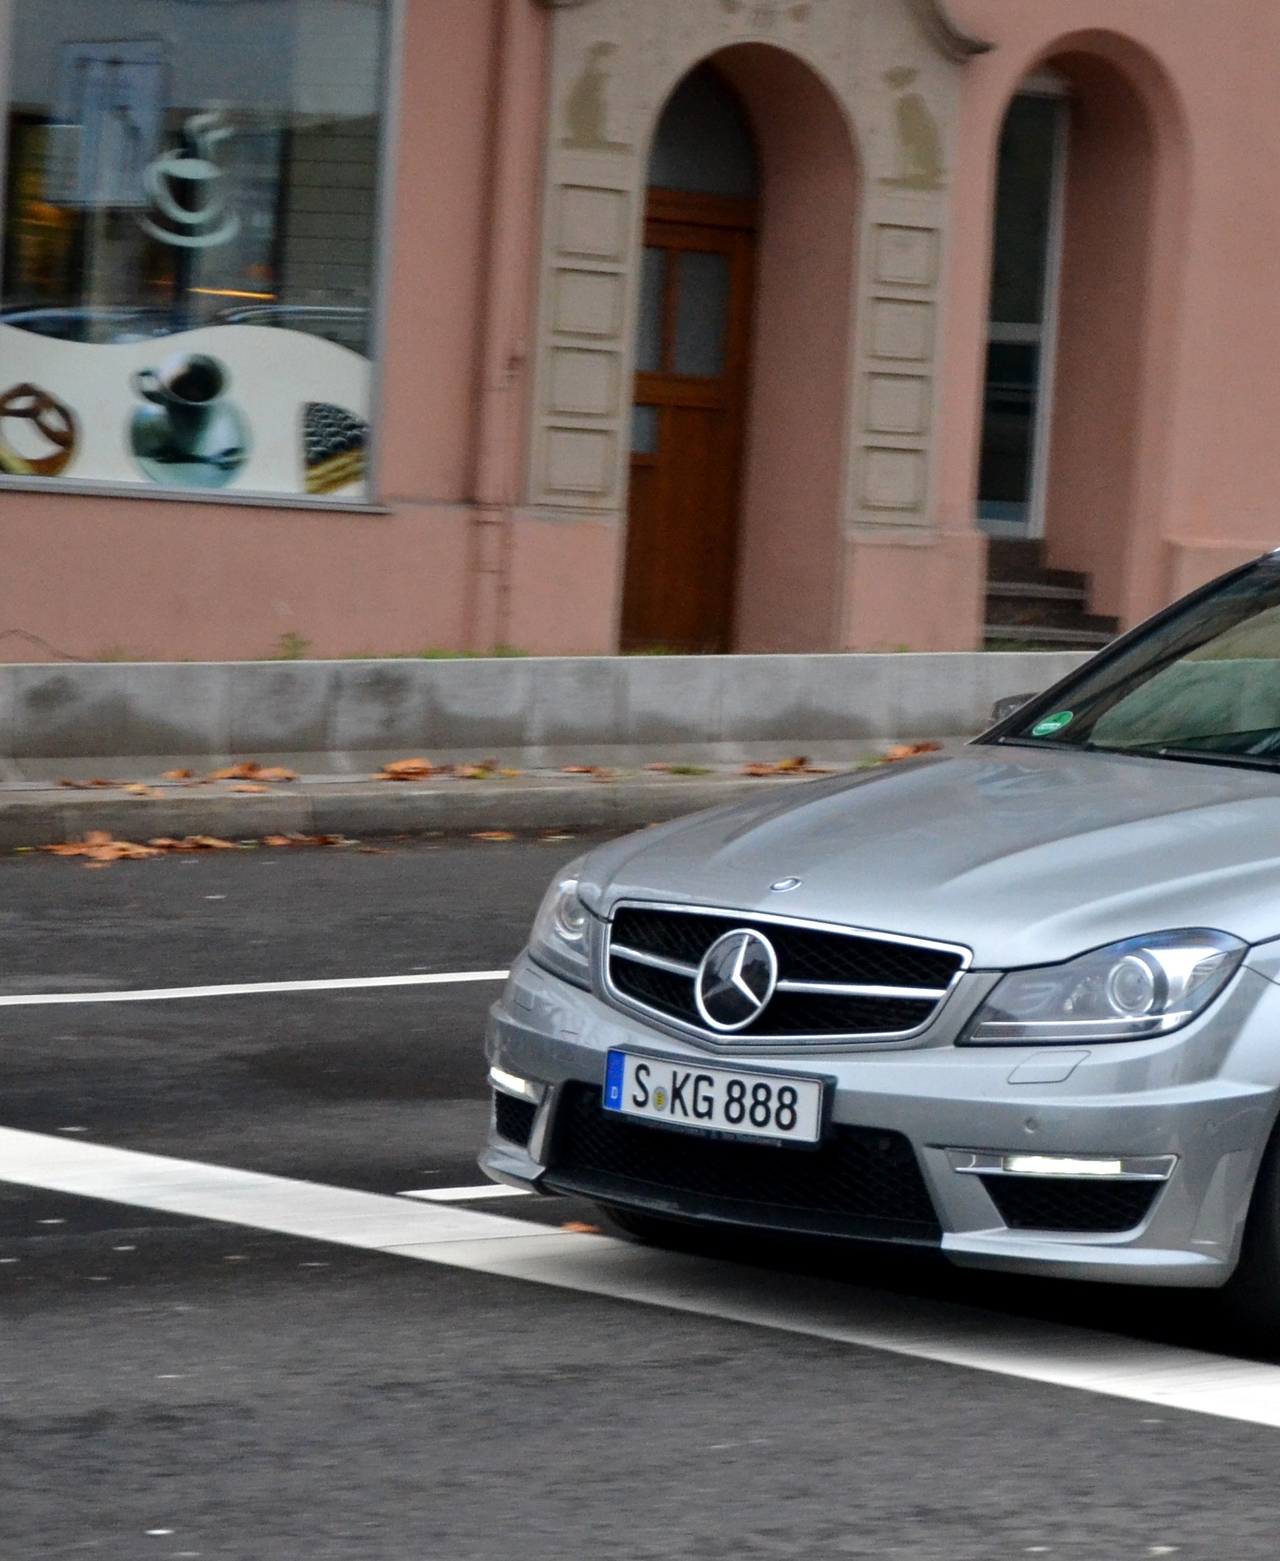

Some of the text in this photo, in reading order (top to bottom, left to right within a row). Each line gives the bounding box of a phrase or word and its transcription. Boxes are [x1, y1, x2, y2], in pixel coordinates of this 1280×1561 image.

[632, 1063, 798, 1132] S KG 888
